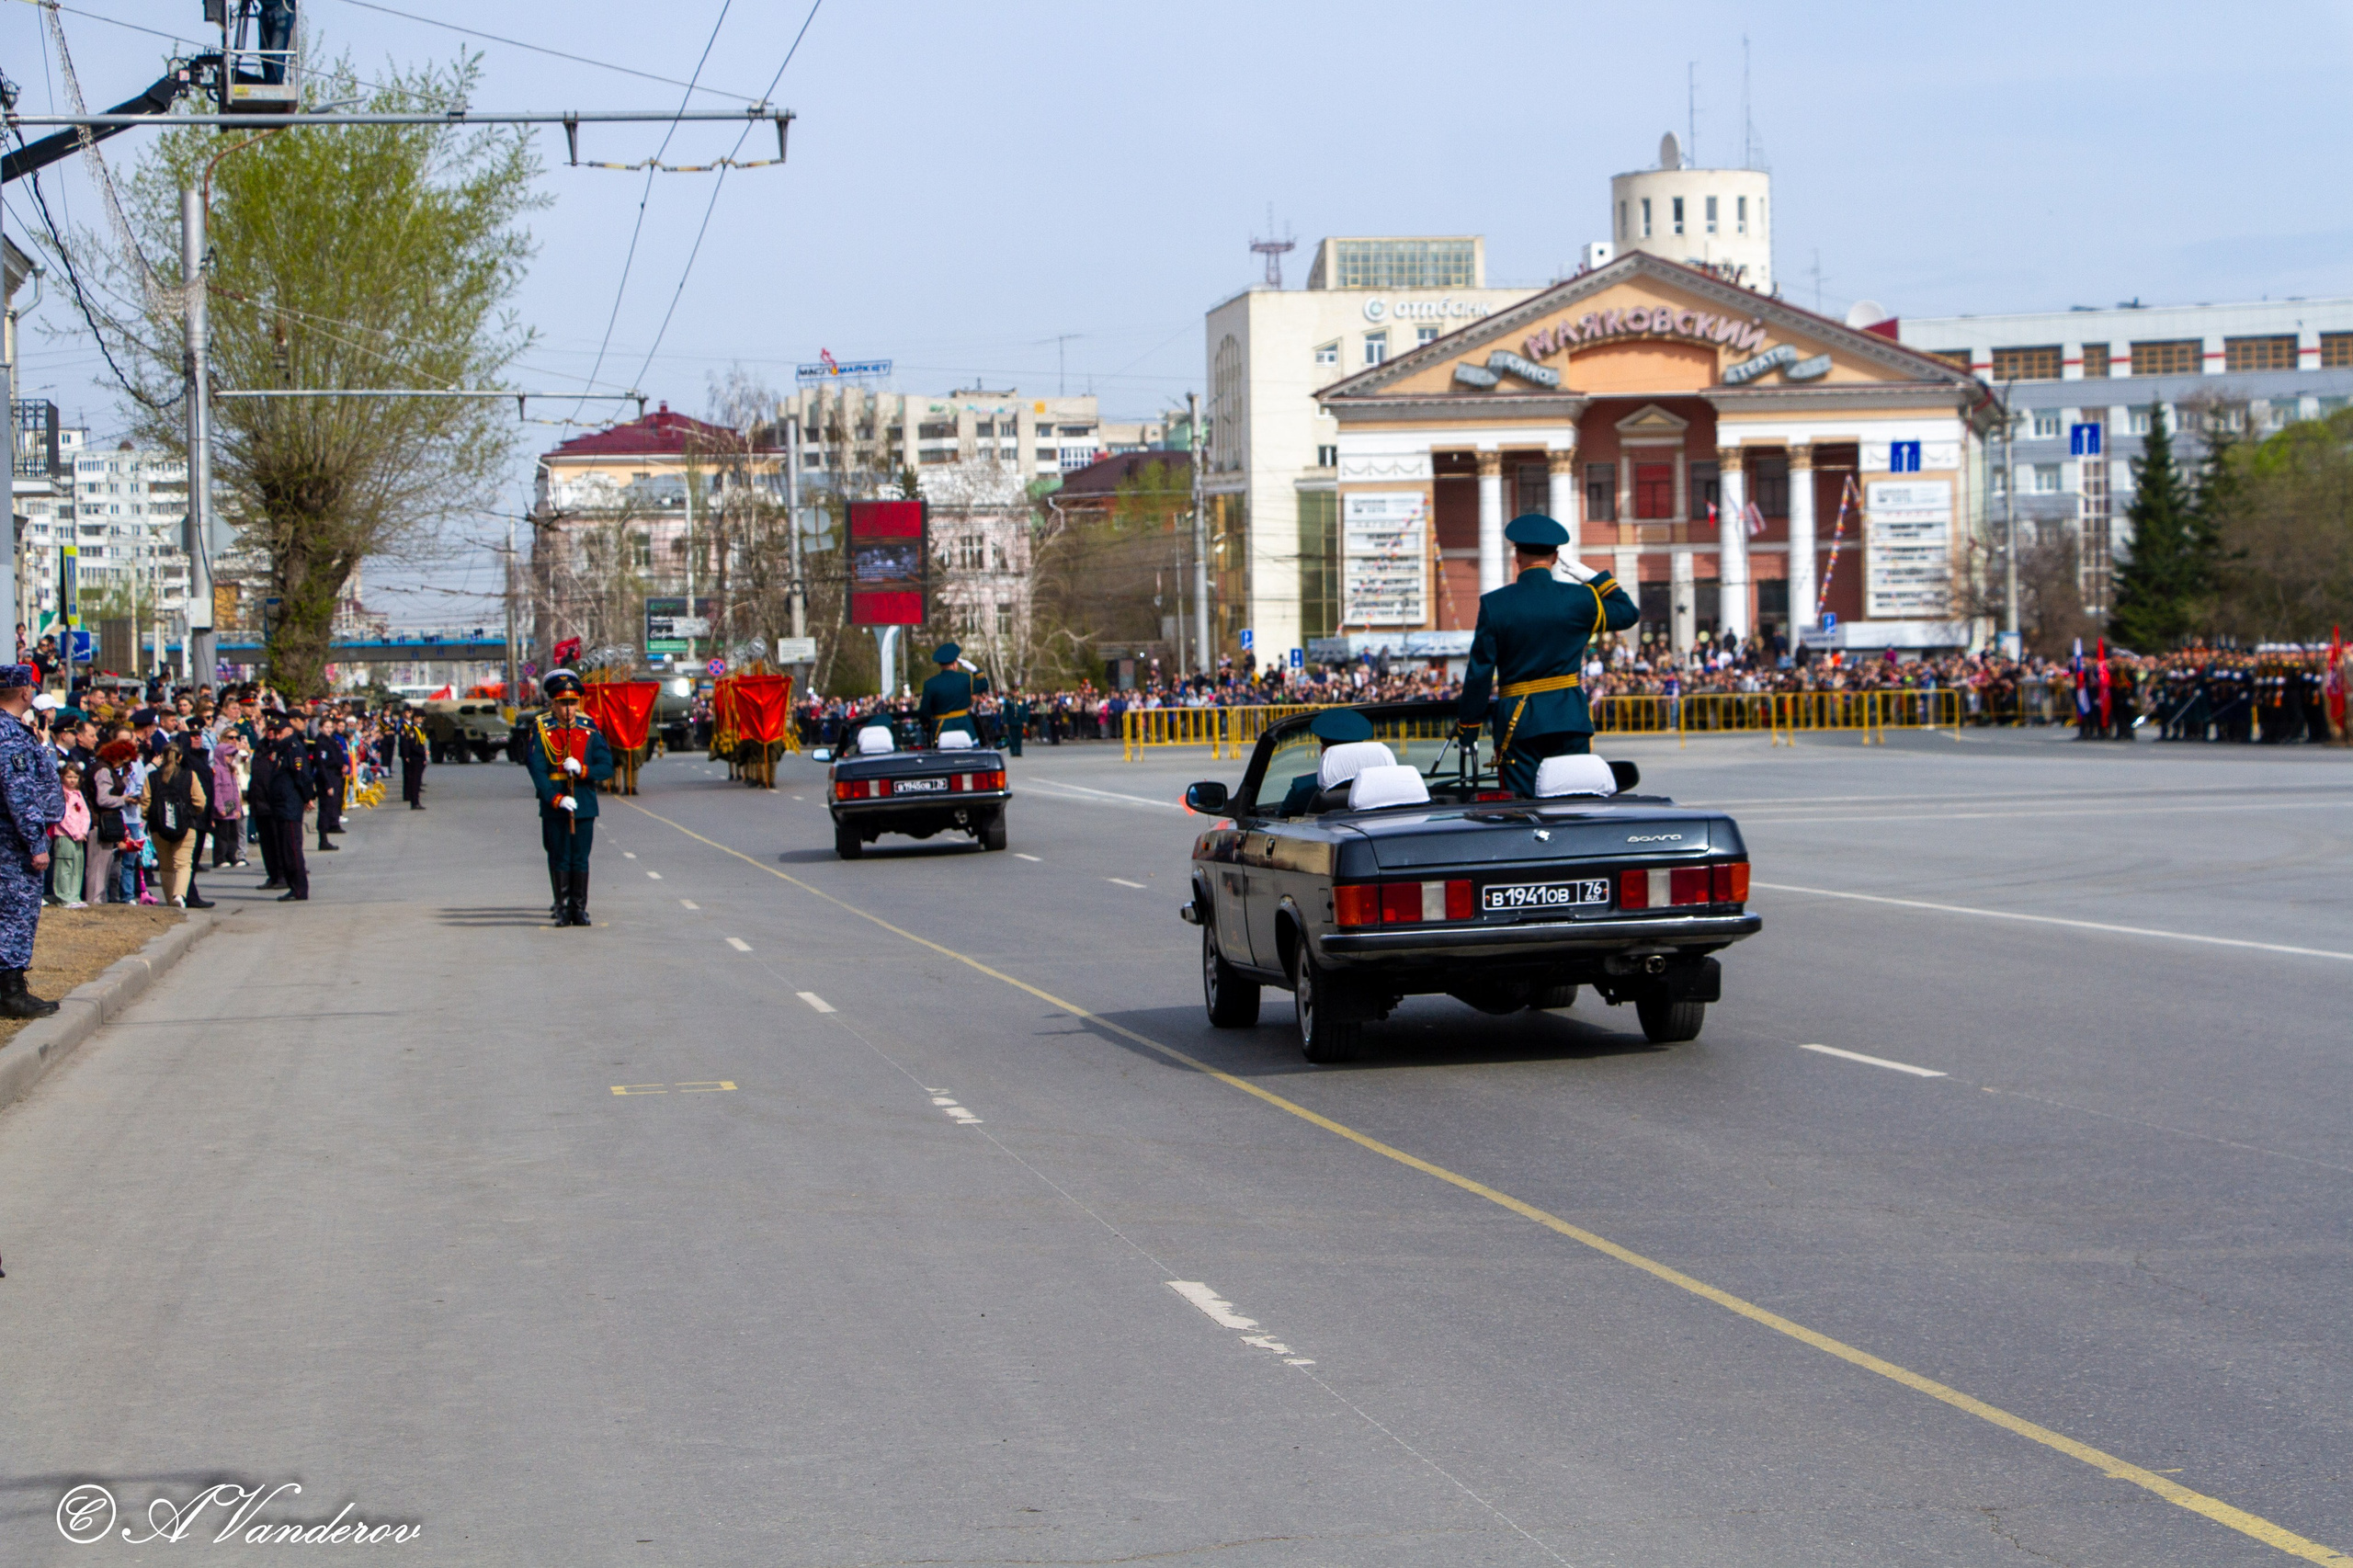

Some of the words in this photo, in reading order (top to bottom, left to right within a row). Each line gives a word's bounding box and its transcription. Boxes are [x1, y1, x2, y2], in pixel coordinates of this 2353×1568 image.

[1524, 306, 1768, 360] МАЯКОВСКИЙ
[1506, 353, 1549, 382] КИНО
[1585, 881, 1602, 895] 76
[1585, 894, 1600, 903] RUS
